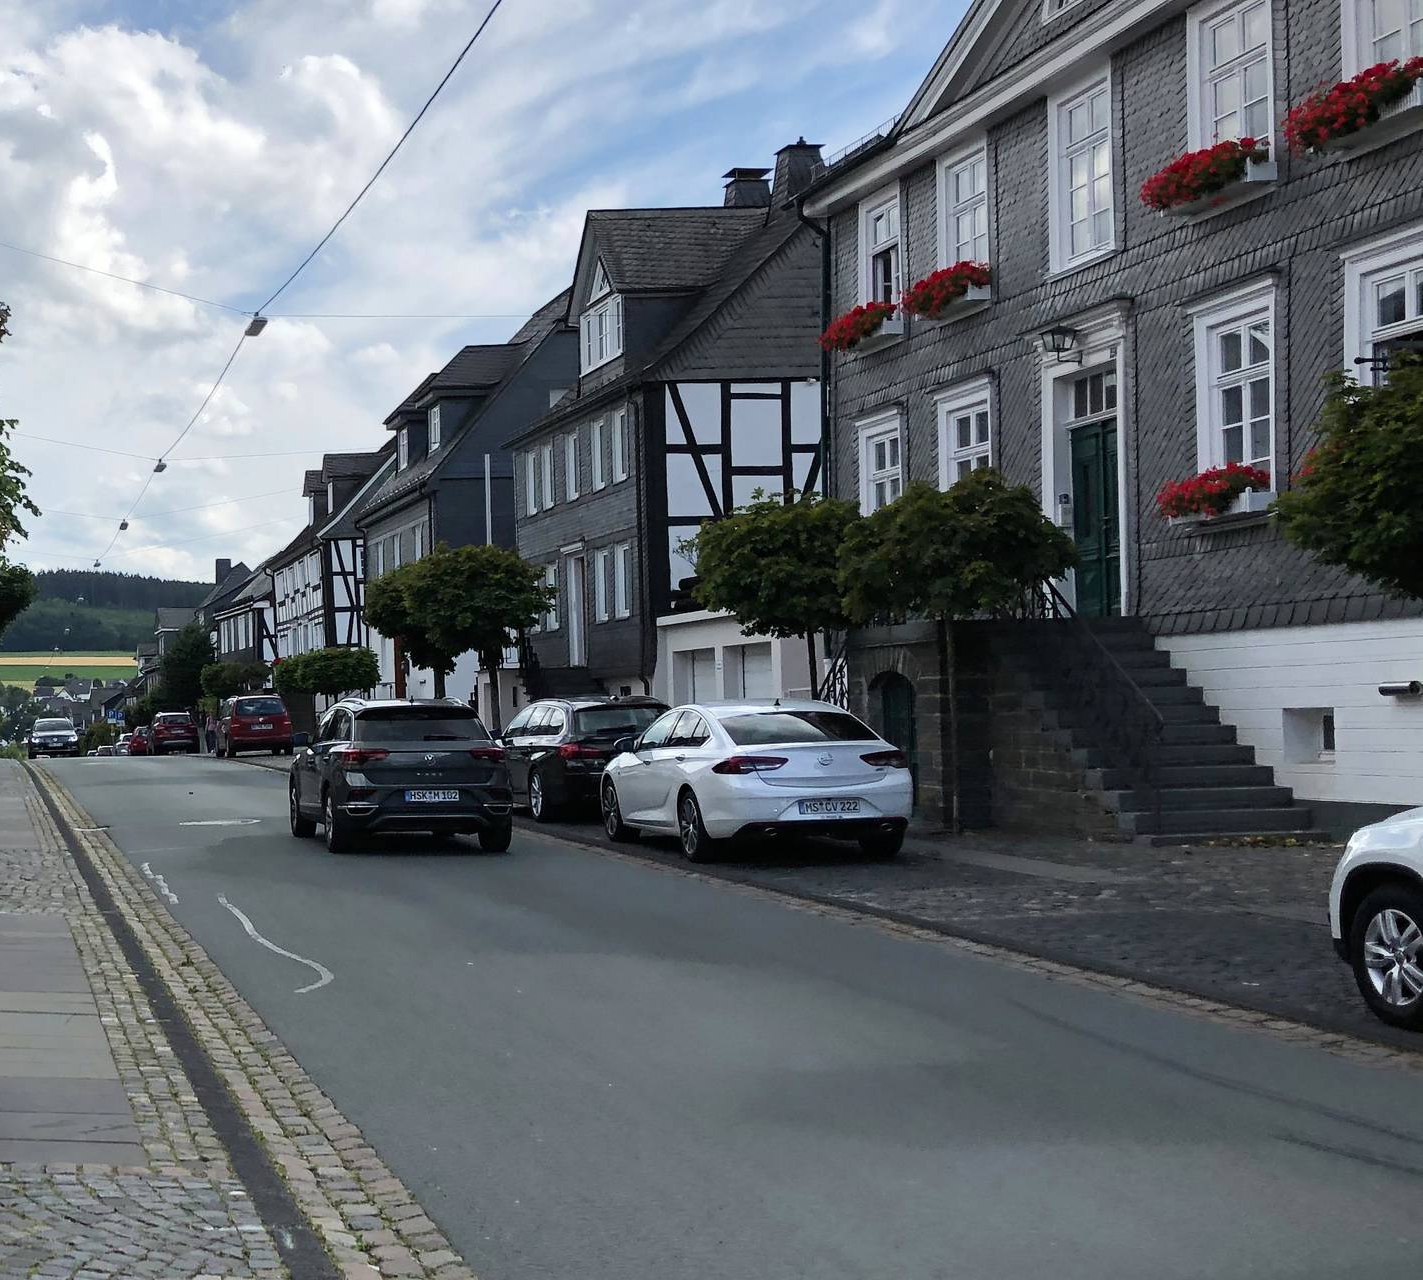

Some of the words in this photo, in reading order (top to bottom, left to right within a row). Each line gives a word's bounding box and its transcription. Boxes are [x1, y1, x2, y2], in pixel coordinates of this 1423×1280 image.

[410, 791, 427, 800] HSK
[433, 791, 440, 800] M
[840, 801, 858, 811] 222
